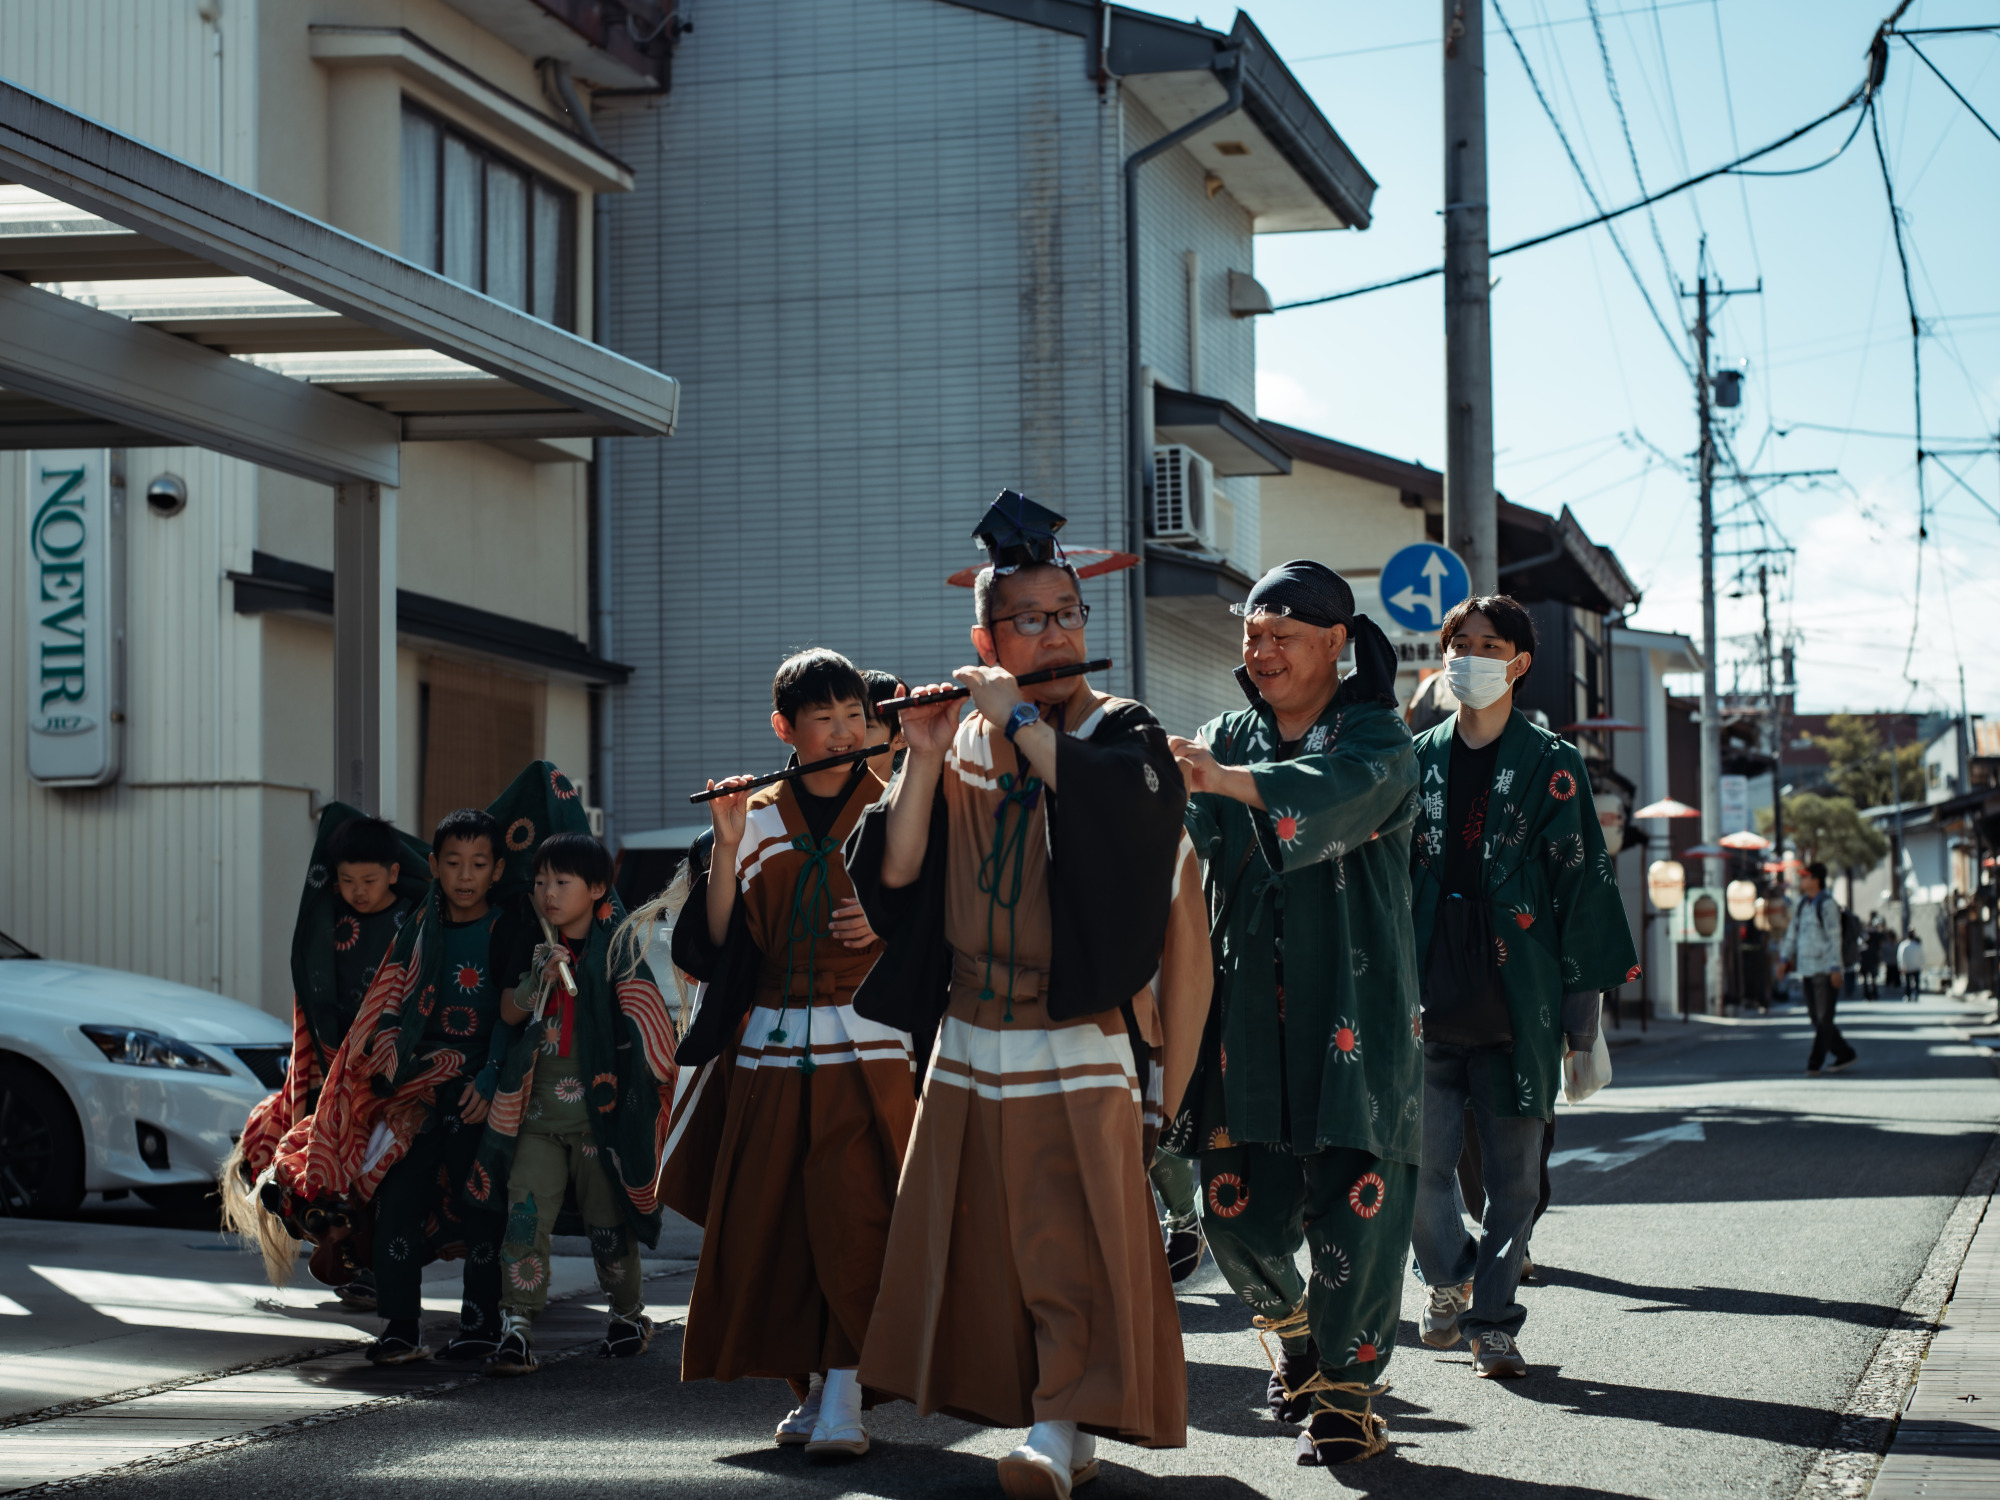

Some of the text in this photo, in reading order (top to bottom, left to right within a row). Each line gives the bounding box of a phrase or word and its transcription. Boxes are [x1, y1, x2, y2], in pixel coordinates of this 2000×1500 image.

[31, 464, 86, 714] NOEVIR
[1246, 731, 1272, 765] 八
[1423, 763, 1445, 856] 八幡宮
